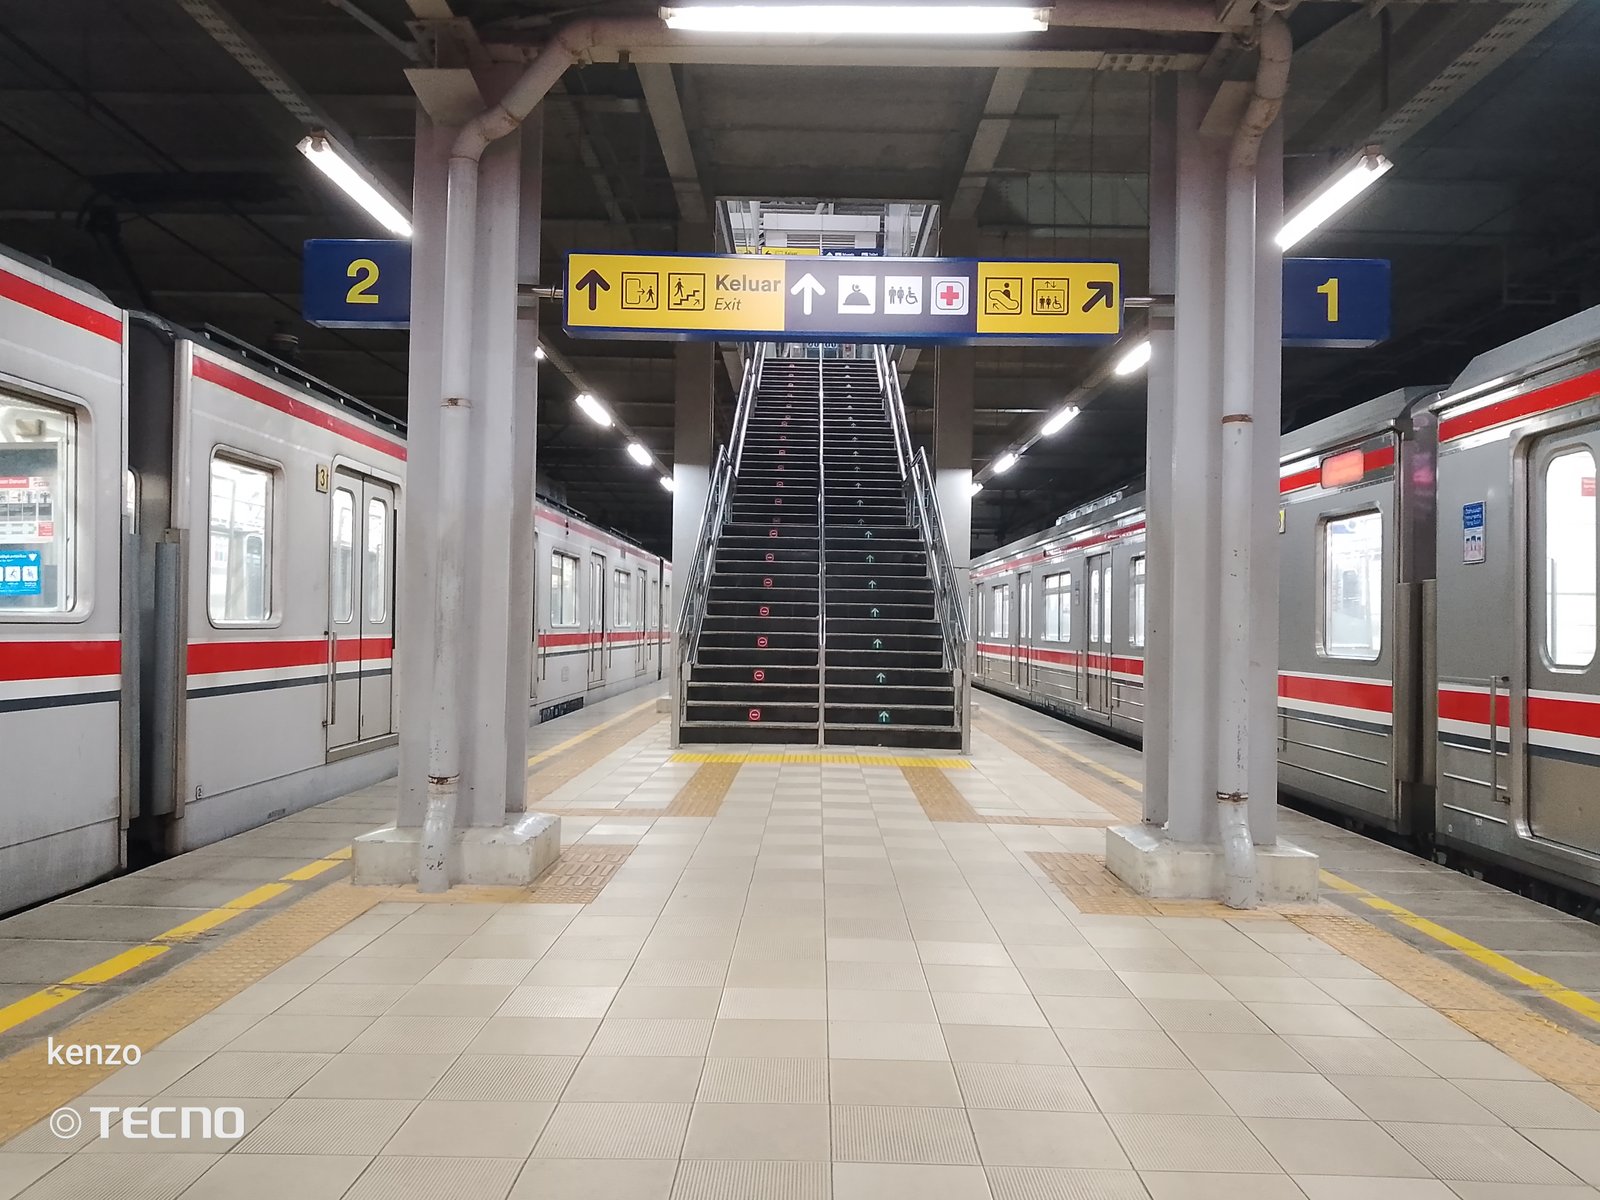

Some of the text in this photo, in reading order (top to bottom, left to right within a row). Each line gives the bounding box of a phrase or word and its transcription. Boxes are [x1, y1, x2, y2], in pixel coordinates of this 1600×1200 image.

[346, 259, 380, 304] 2
[715, 274, 782, 292] Keluar
[714, 297, 742, 311] Exit
[1317, 278, 1339, 322] 1
[320, 469, 326, 487] 3
